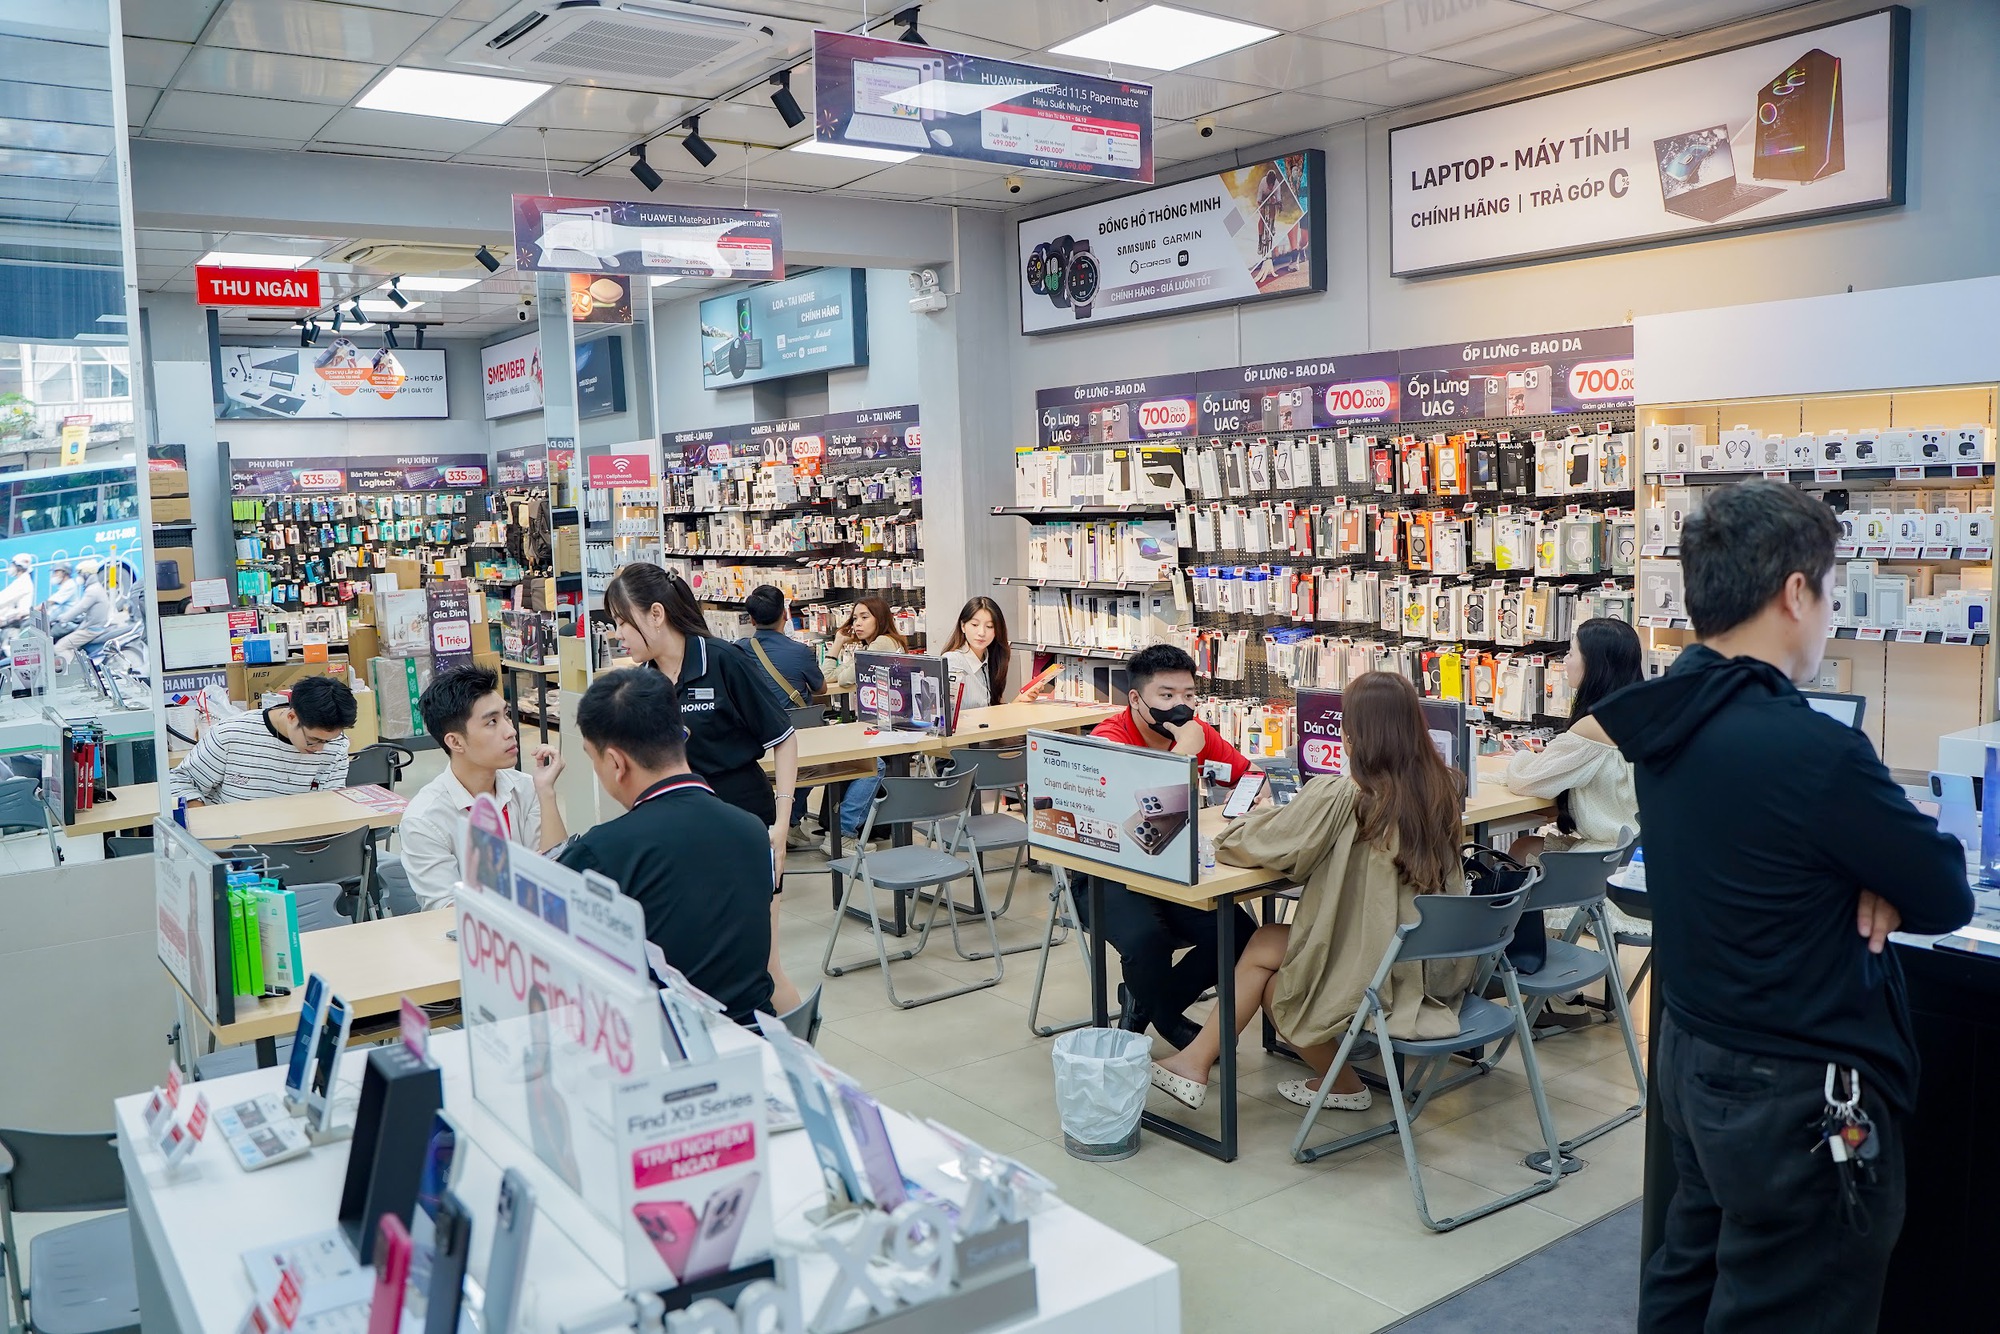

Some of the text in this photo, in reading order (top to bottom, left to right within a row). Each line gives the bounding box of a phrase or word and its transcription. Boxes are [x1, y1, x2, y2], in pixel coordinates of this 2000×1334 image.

[1069, 88, 1087, 100] 11.5
[1090, 90, 1139, 108] Papermatte
[1130, 88, 1149, 96] HUAWEI
[1032, 97, 1092, 114] Hiệu Suất Như PC
[1030, 158, 1039, 166] Giá
[1040, 159, 1049, 167] Chỉ
[1050, 160, 1057, 168] Từ
[1412, 127, 1630, 191] LAPTOP MÁY TÍNH
[1411, 178, 1605, 228] CHÍNH HÃNG TRẢ GÓP
[640, 214, 770, 228] HUAWEI MatePad 11.5 Papermatte
[1098, 196, 1221, 235] ĐỒNG HỒ THÔNG MINH
[1118, 230, 1202, 256] SAMSUNG GARMIN
[210, 279, 308, 298] THU NGÂN
[1111, 274, 1211, 302] CHÍNH HÃNG GIÁ LUÔN TỐT
[772, 292, 815, 311] LOA TAI NGHE
[801, 305, 840, 323] CHÍNH HÃNG
[1462, 338, 1582, 362] ỐP LƯNG BAO DA
[430, 374, 443, 382] TẬP
[488, 358, 526, 385] SMEMBER
[1244, 362, 1336, 382] ỐP LƯNG BAO DA
[1074, 382, 1146, 400] ỐP LƯNG BAO DA
[1408, 376, 1470, 398] Ốp Lưng
[1203, 394, 1250, 415] Ốp Lưng
[1422, 400, 1455, 417] UAG
[857, 411, 901, 423] LOA TAI NGHE
[1043, 410, 1080, 428] Ốp Lưng
[1214, 416, 1239, 432] UAG
[751, 425, 772, 435] CAMERA
[776, 421, 787, 432] MÁY
[1052, 430, 1072, 443] UAG
[832, 434, 856, 445] Tai nghe
[828, 446, 862, 457] Sony Inzone
[267, 460, 286, 468] KIỆN
[414, 456, 431, 465] KIỆN
[359, 479, 395, 489] Logitech
[440, 600, 459, 609] Điện
[433, 608, 468, 619] Gia Đình
[438, 634, 467, 647] 1 Triệu
[163, 674, 225, 691] HANH TOÁN
[859, 673, 871, 682] Dán
[681, 702, 715, 713] HONOR
[1304, 721, 1324, 735] Dán
[1308, 744, 1320, 752] Giá
[1044, 756, 1099, 775] xiaomi 15T Series
[1311, 755, 1318, 763] Từ
[1044, 777, 1062, 790] Chạm
[1078, 782, 1095, 798] tuyệt
[1096, 787, 1106, 799] tác
[1055, 798, 1063, 806] Giá
[1083, 804, 1095, 813] Triệu
[1080, 822, 1092, 834] 2.5
[462, 912, 634, 1074] OPPO Find X9
[628, 1108, 667, 1134] Find
[671, 1104, 694, 1123] X9
[700, 1094, 752, 1116] Series
[672, 1153, 719, 1179] NGAY
